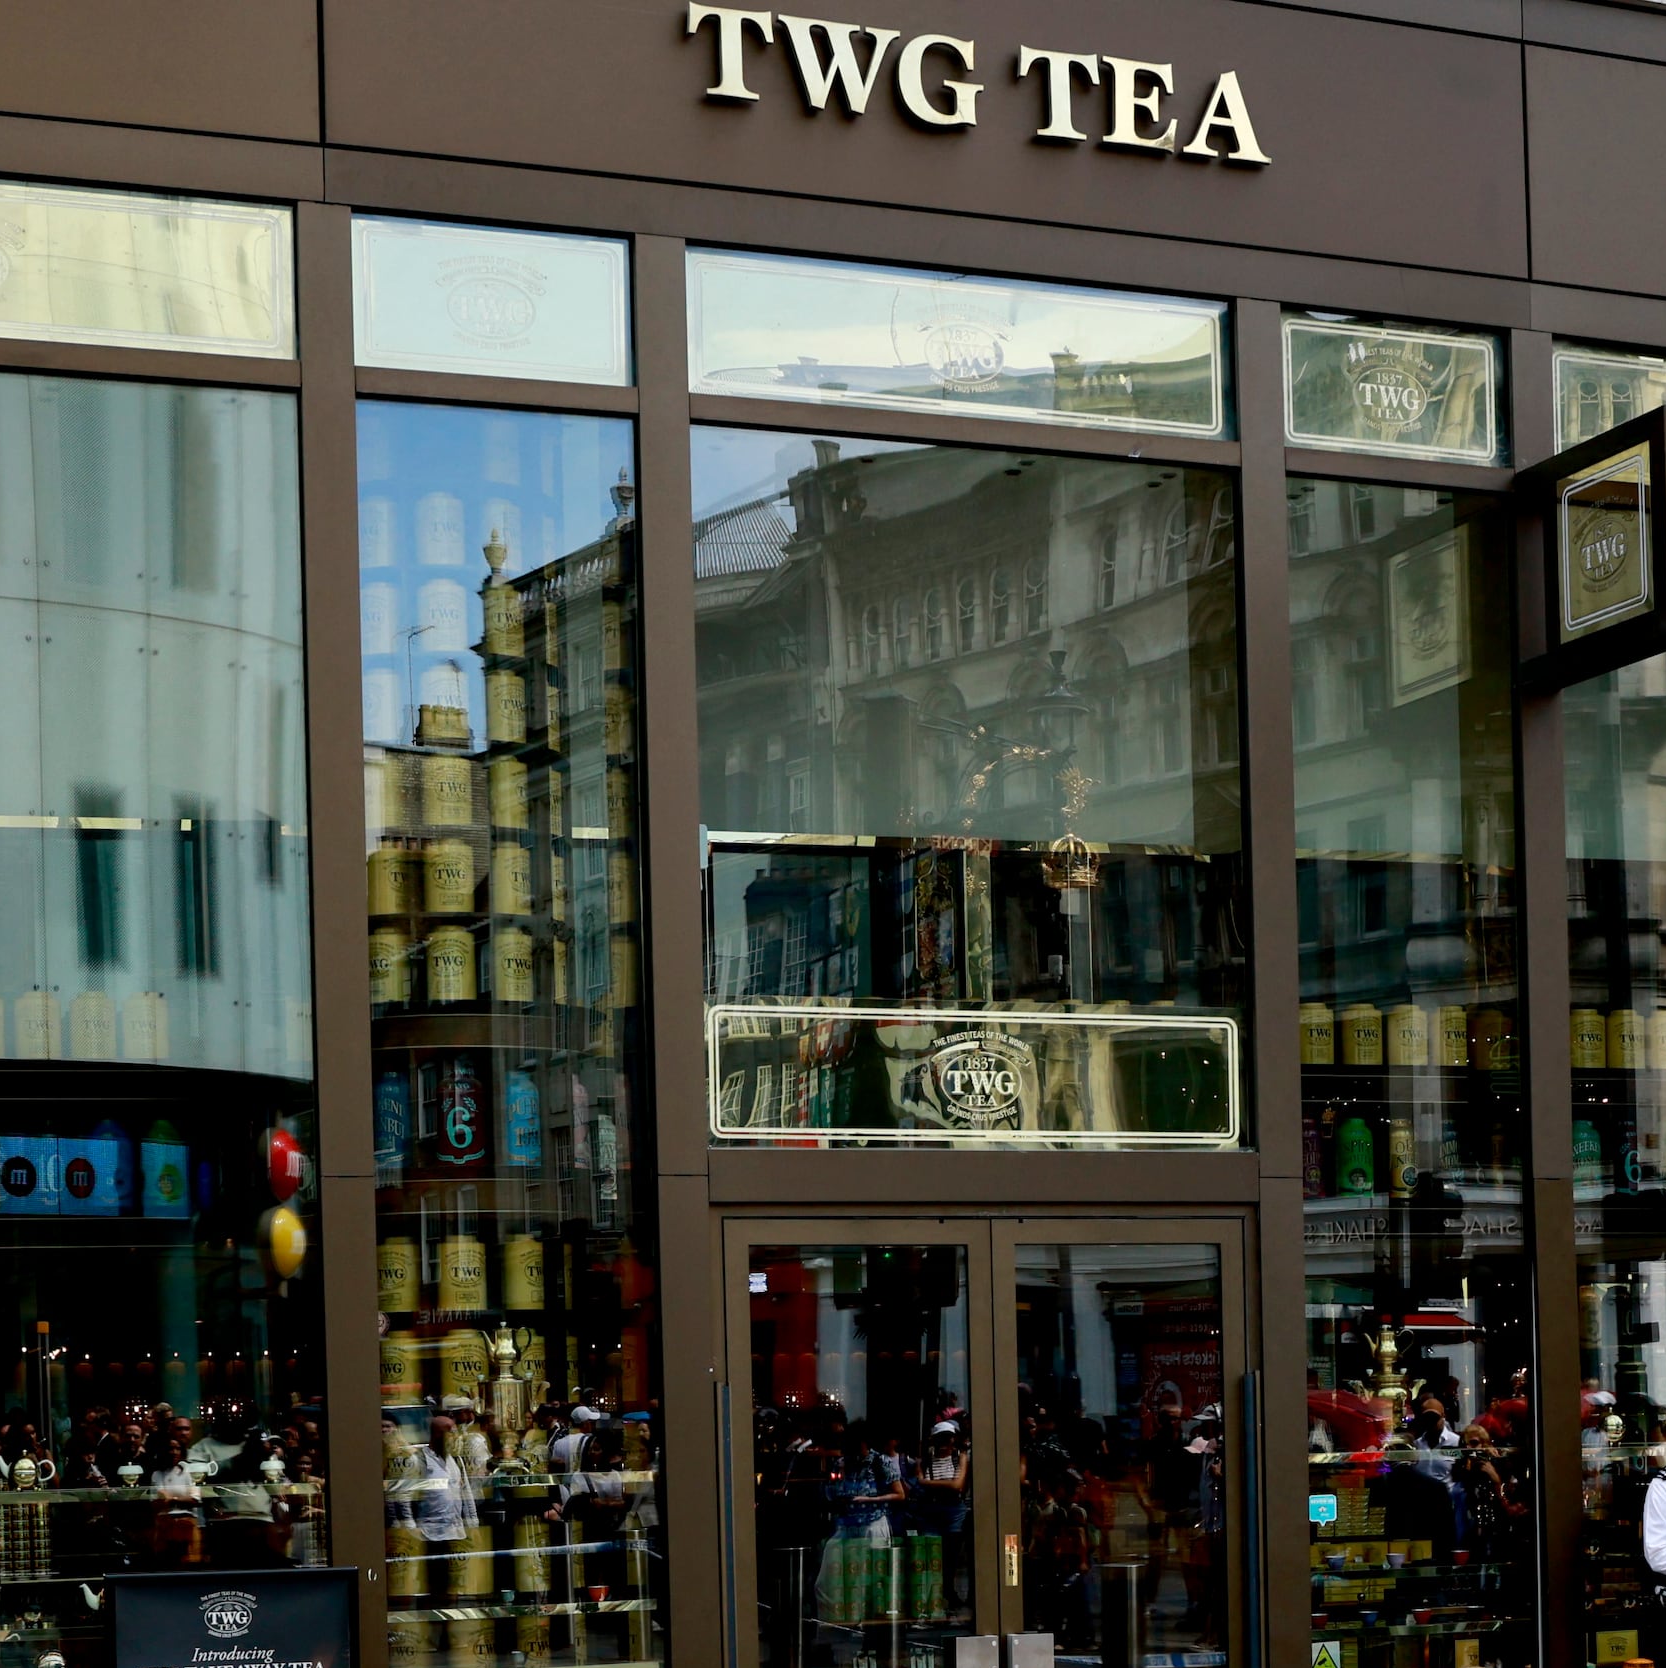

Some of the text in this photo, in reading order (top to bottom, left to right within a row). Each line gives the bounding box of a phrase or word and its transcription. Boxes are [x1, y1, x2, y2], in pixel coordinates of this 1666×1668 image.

[686, 1, 1271, 166] TWG TEA
[1376, 372, 1403, 386] 1837
[1358, 383, 1421, 411] TWG
[1377, 407, 1404, 420] TEA
[1580, 533, 1625, 571] TWG
[437, 782, 466, 794] TWG
[435, 869, 466, 880] TWG
[433, 955, 464, 967] TWG
[1309, 1028, 1332, 1038] TWG
[1355, 1029, 1379, 1039] TWG
[1444, 1030, 1467, 1040] TWG
[1578, 1033, 1603, 1043] TWG
[933, 1030, 1030, 1052] THE FINEST TEAS OF THE WORLD
[965, 1056, 996, 1070] 1837
[946, 1070, 1016, 1096] TWG
[964, 1094, 998, 1107] TEA
[946, 1104, 1018, 1121] GRANDS CRUS PRESTIGE
[446, 1106, 474, 1149] 6
[1624, 1149, 1642, 1184] 6
[451, 1266, 481, 1278] TWG
[451, 1360, 482, 1372] TWG
[208, 1610, 249, 1626] TWG
[218, 1623, 238, 1631] TEA
[191, 1646, 275, 1664] Introducing
